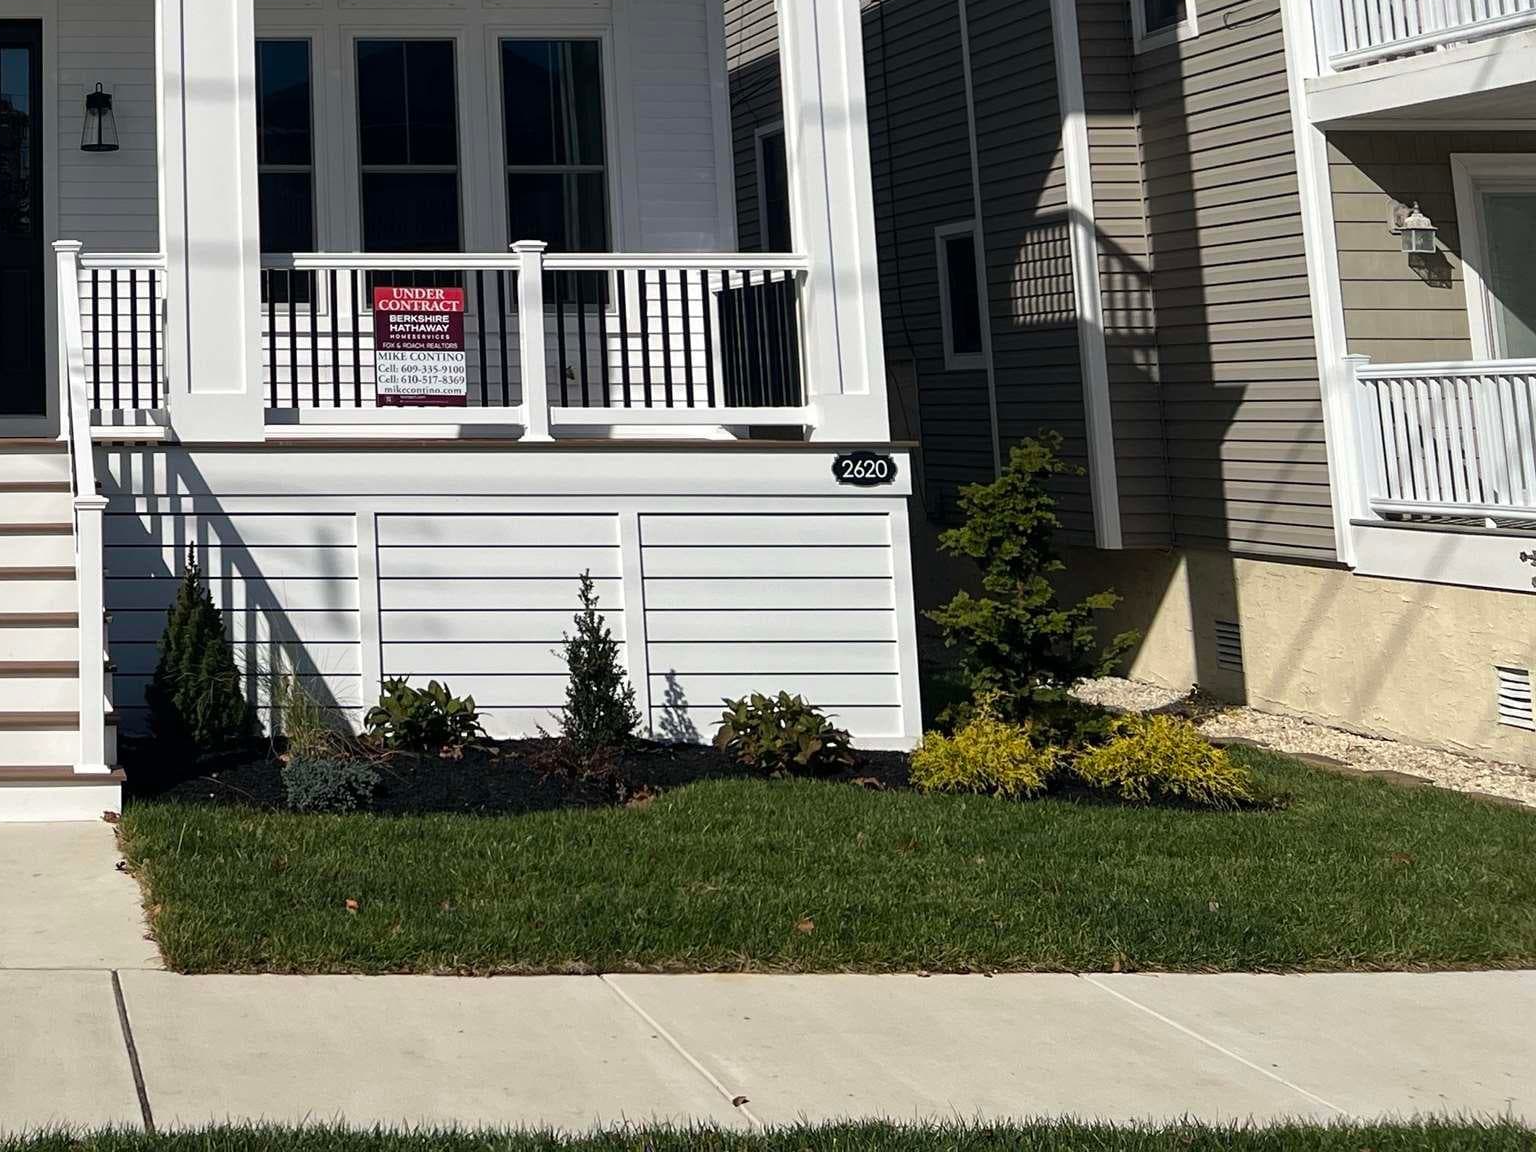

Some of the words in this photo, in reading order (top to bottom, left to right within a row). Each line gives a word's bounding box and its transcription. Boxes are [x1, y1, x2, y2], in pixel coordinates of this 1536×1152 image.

[392, 288, 445, 299] UNDER
[378, 300, 460, 312] CONTRACT
[389, 314, 450, 323] BERKSHIRE
[389, 324, 450, 332] HATHAWAY
[378, 352, 407, 361] MIKE
[409, 352, 464, 362] CONTINO
[378, 364, 398, 373] Cell:
[400, 365, 465, 374] 609-335-9100
[378, 374, 399, 384] Cell:
[400, 375, 465, 384] 610-517-8369
[384, 385, 462, 395] mikecontino.com
[842, 459, 888, 478] 2620
